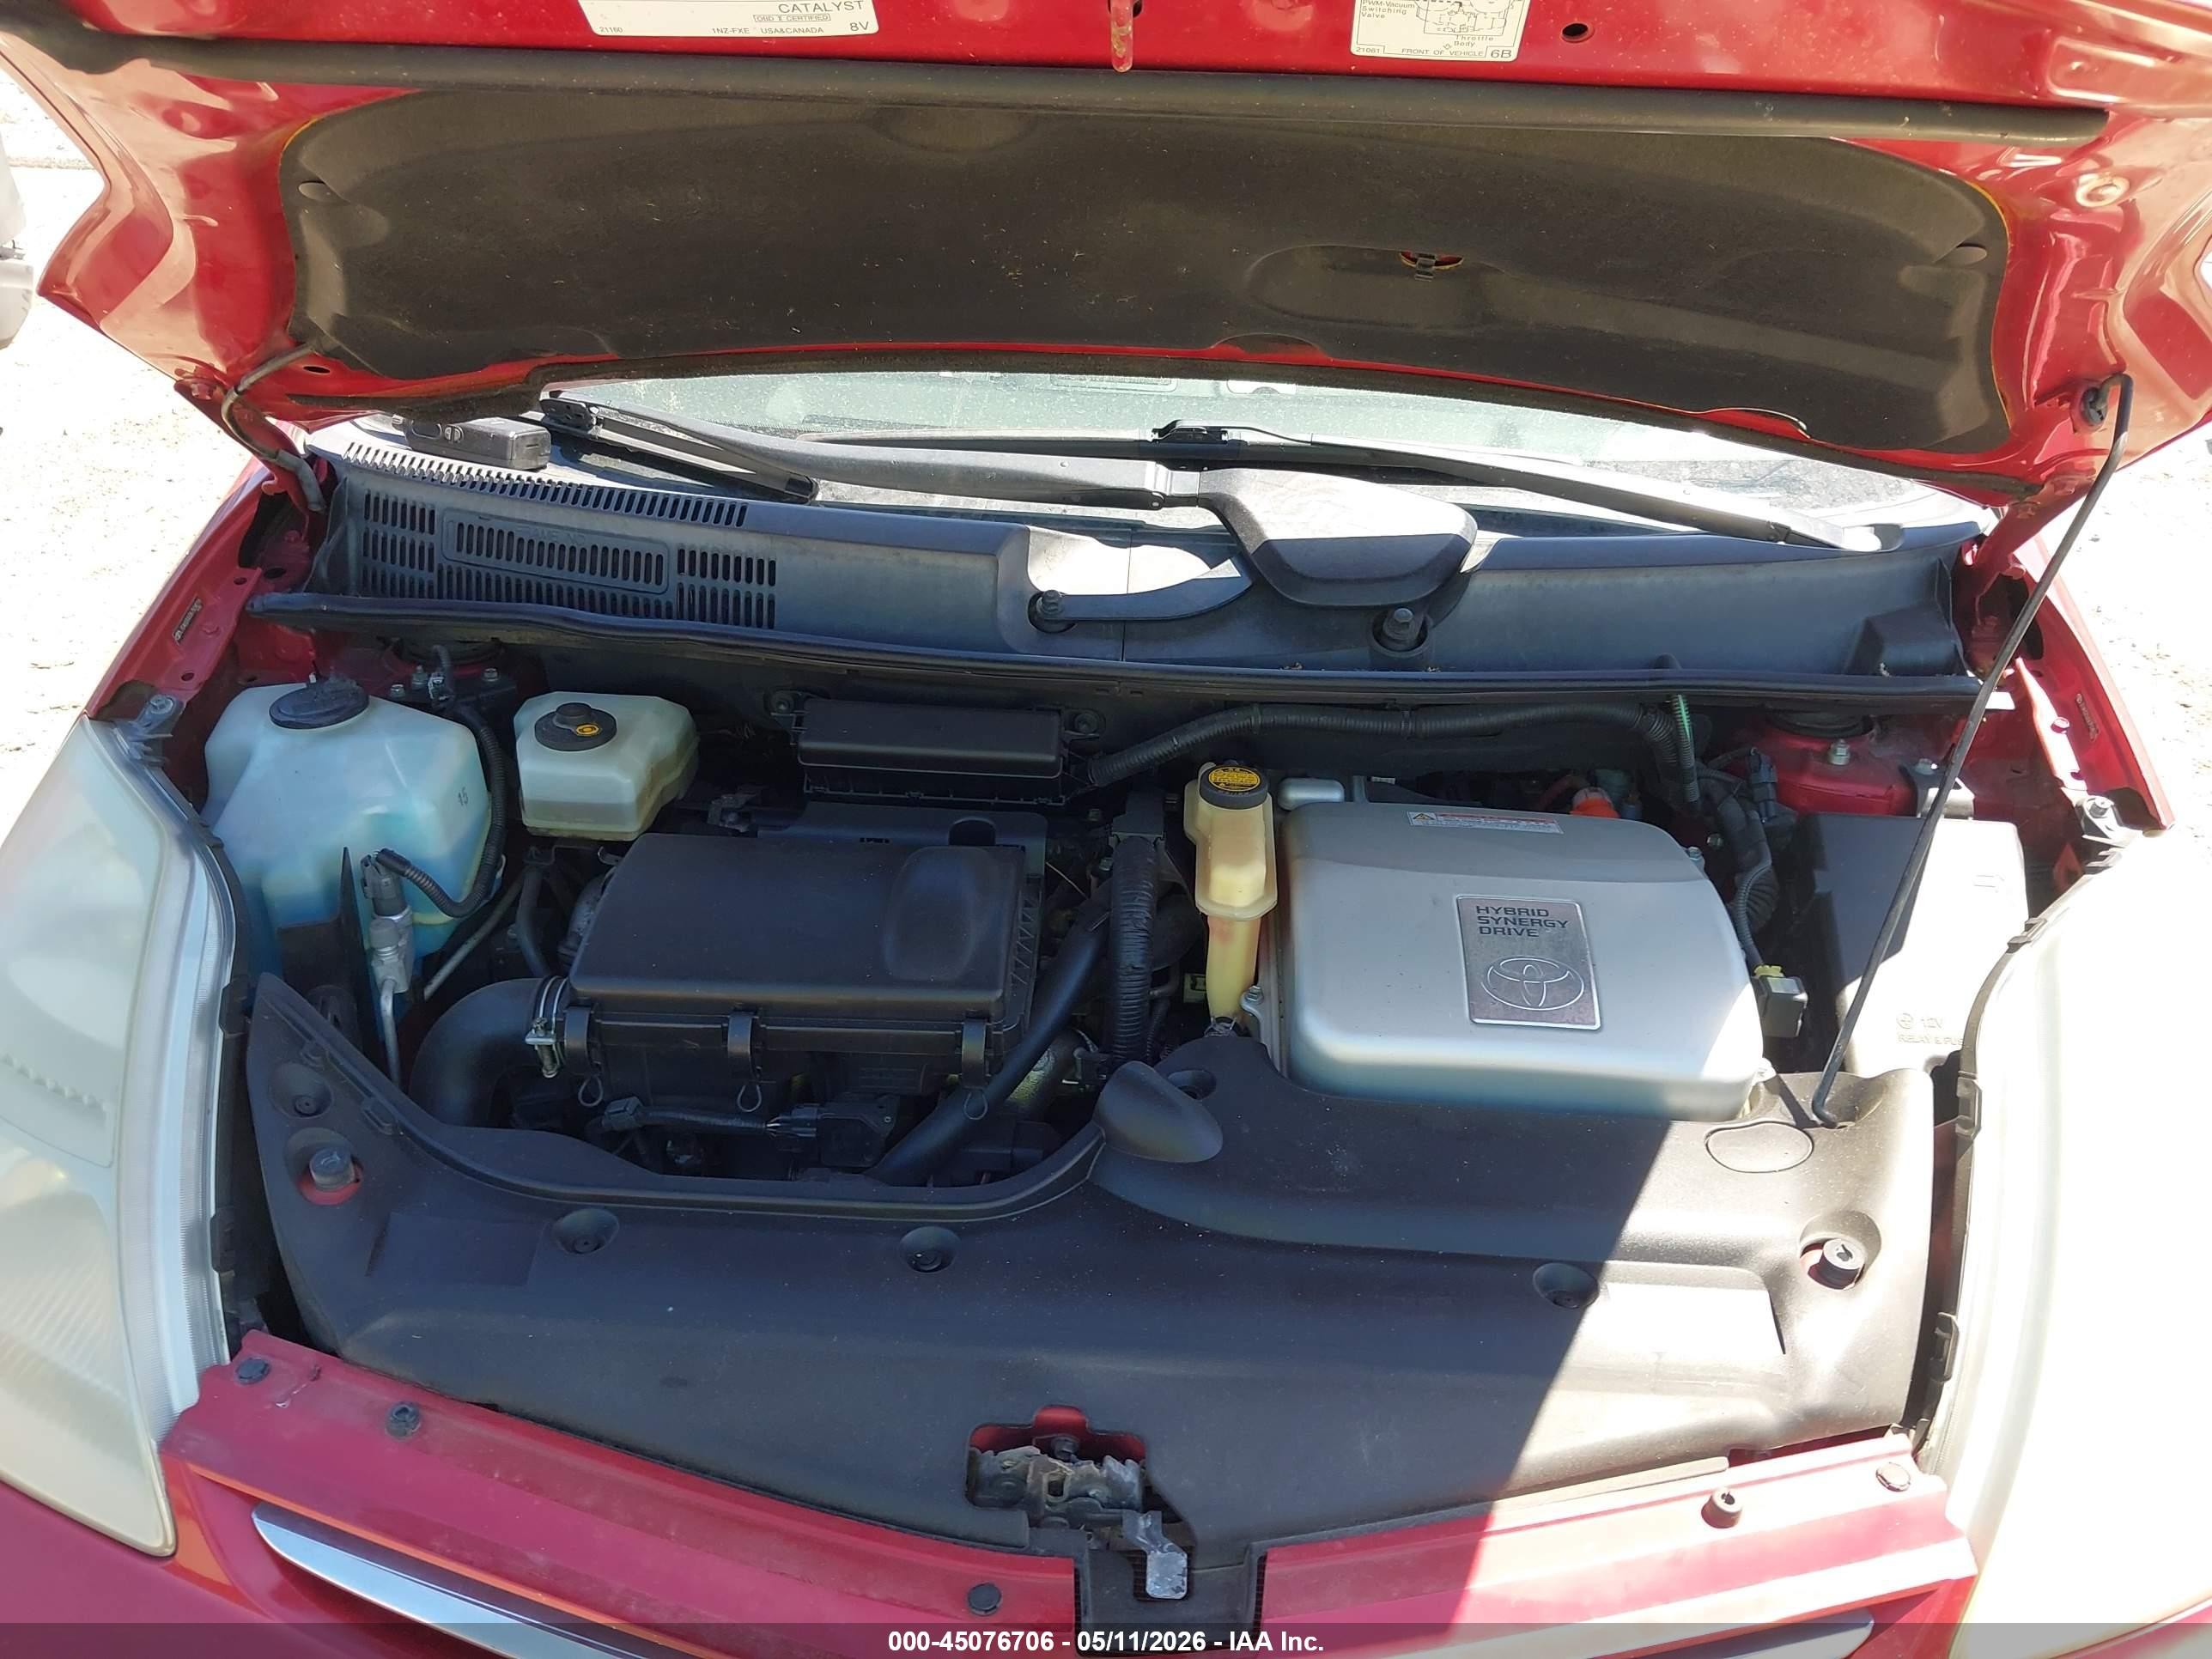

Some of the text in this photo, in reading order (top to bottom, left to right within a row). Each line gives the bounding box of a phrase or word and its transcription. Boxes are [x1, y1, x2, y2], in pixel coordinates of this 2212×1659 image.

[778, 1, 865, 13] CATALYST
[1362, 0, 1415, 9] PWM-Vacuum
[1361, 6, 1407, 15] Switching
[849, 21, 869, 32] 8V
[1490, 49, 1512, 58] 6B
[1476, 905, 1549, 917] HYBRID
[1476, 915, 1569, 929] SYNERGY
[1479, 927, 1540, 937] DRIVE
